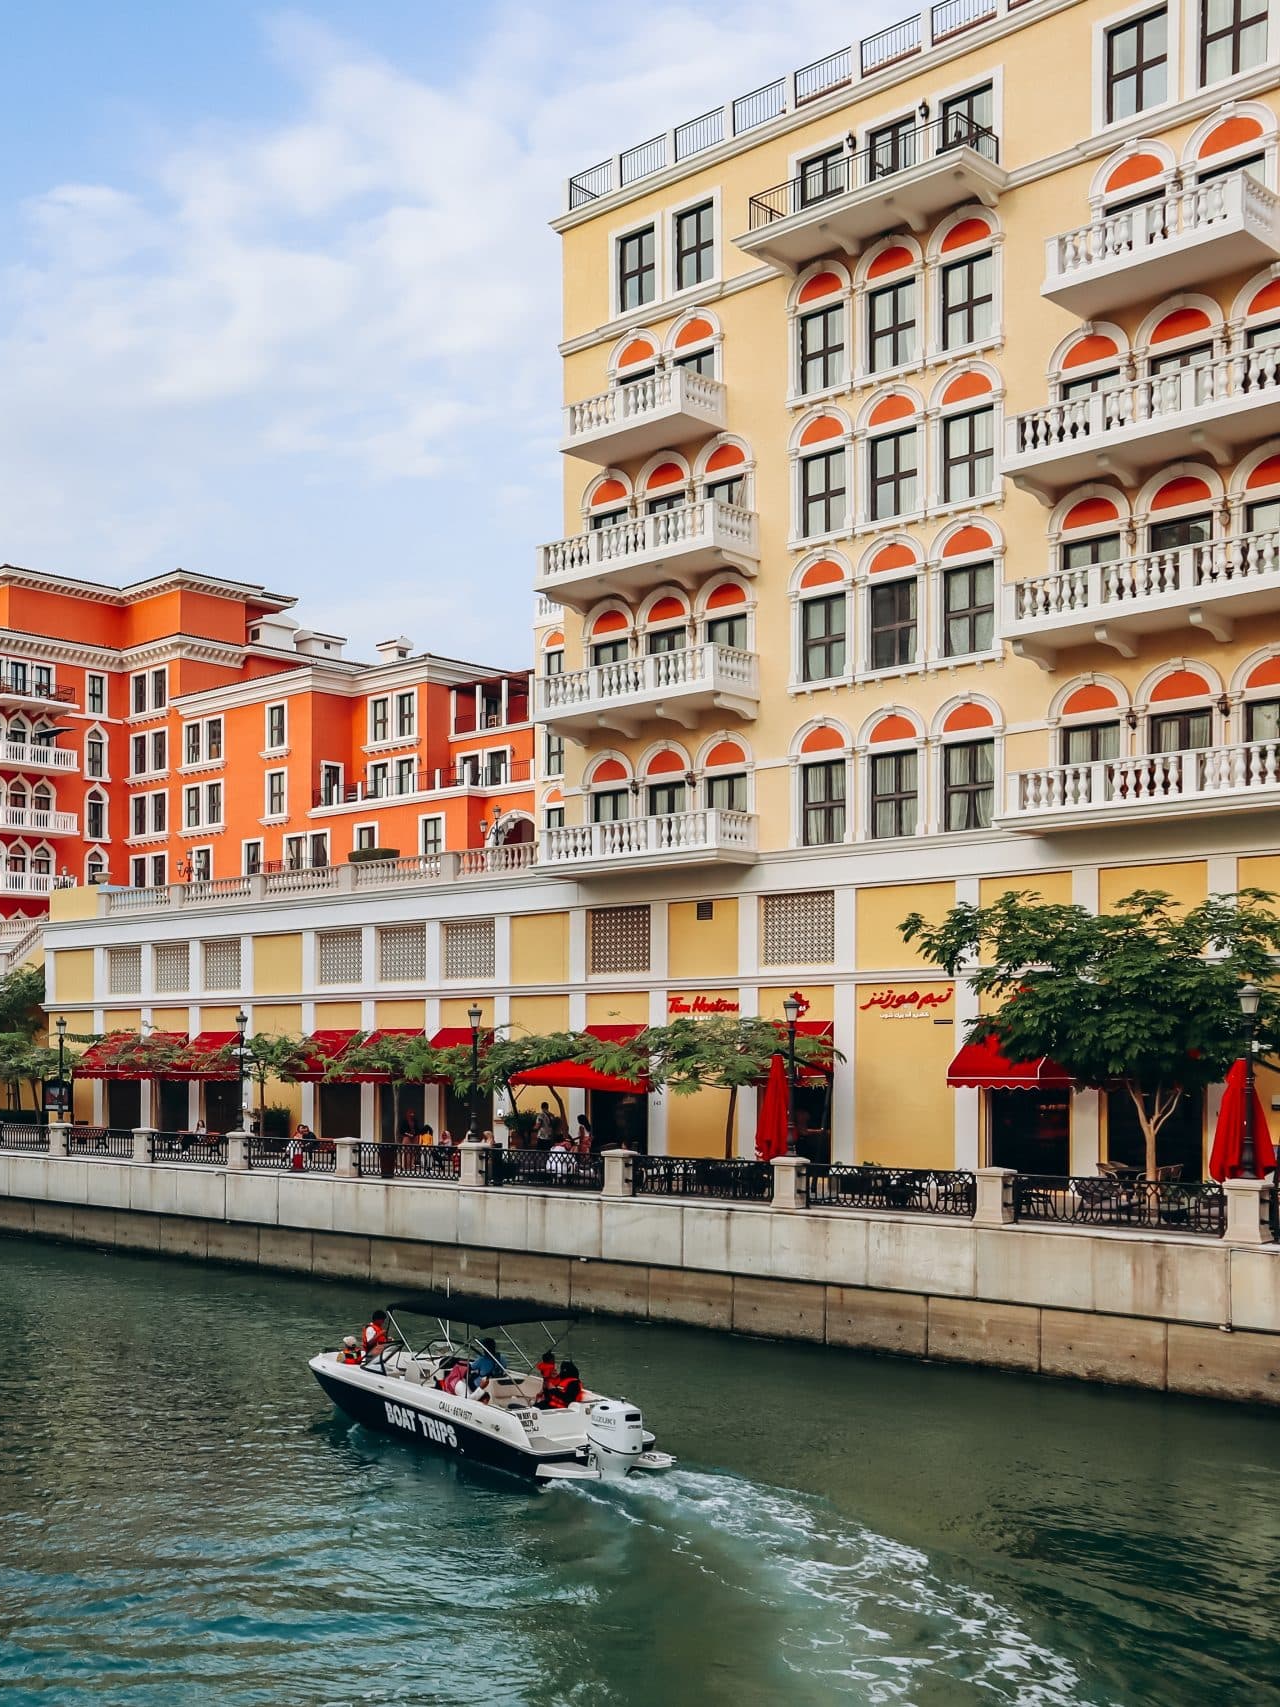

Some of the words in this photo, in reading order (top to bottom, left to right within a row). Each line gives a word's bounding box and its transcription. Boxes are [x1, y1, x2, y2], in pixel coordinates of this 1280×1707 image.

[668, 996, 691, 1014] Tim
[859, 990, 920, 1010] هورتنز
[916, 988, 954, 1010] تيم
[384, 1401, 417, 1433] BOAT
[417, 1413, 458, 1448] TRIPS
